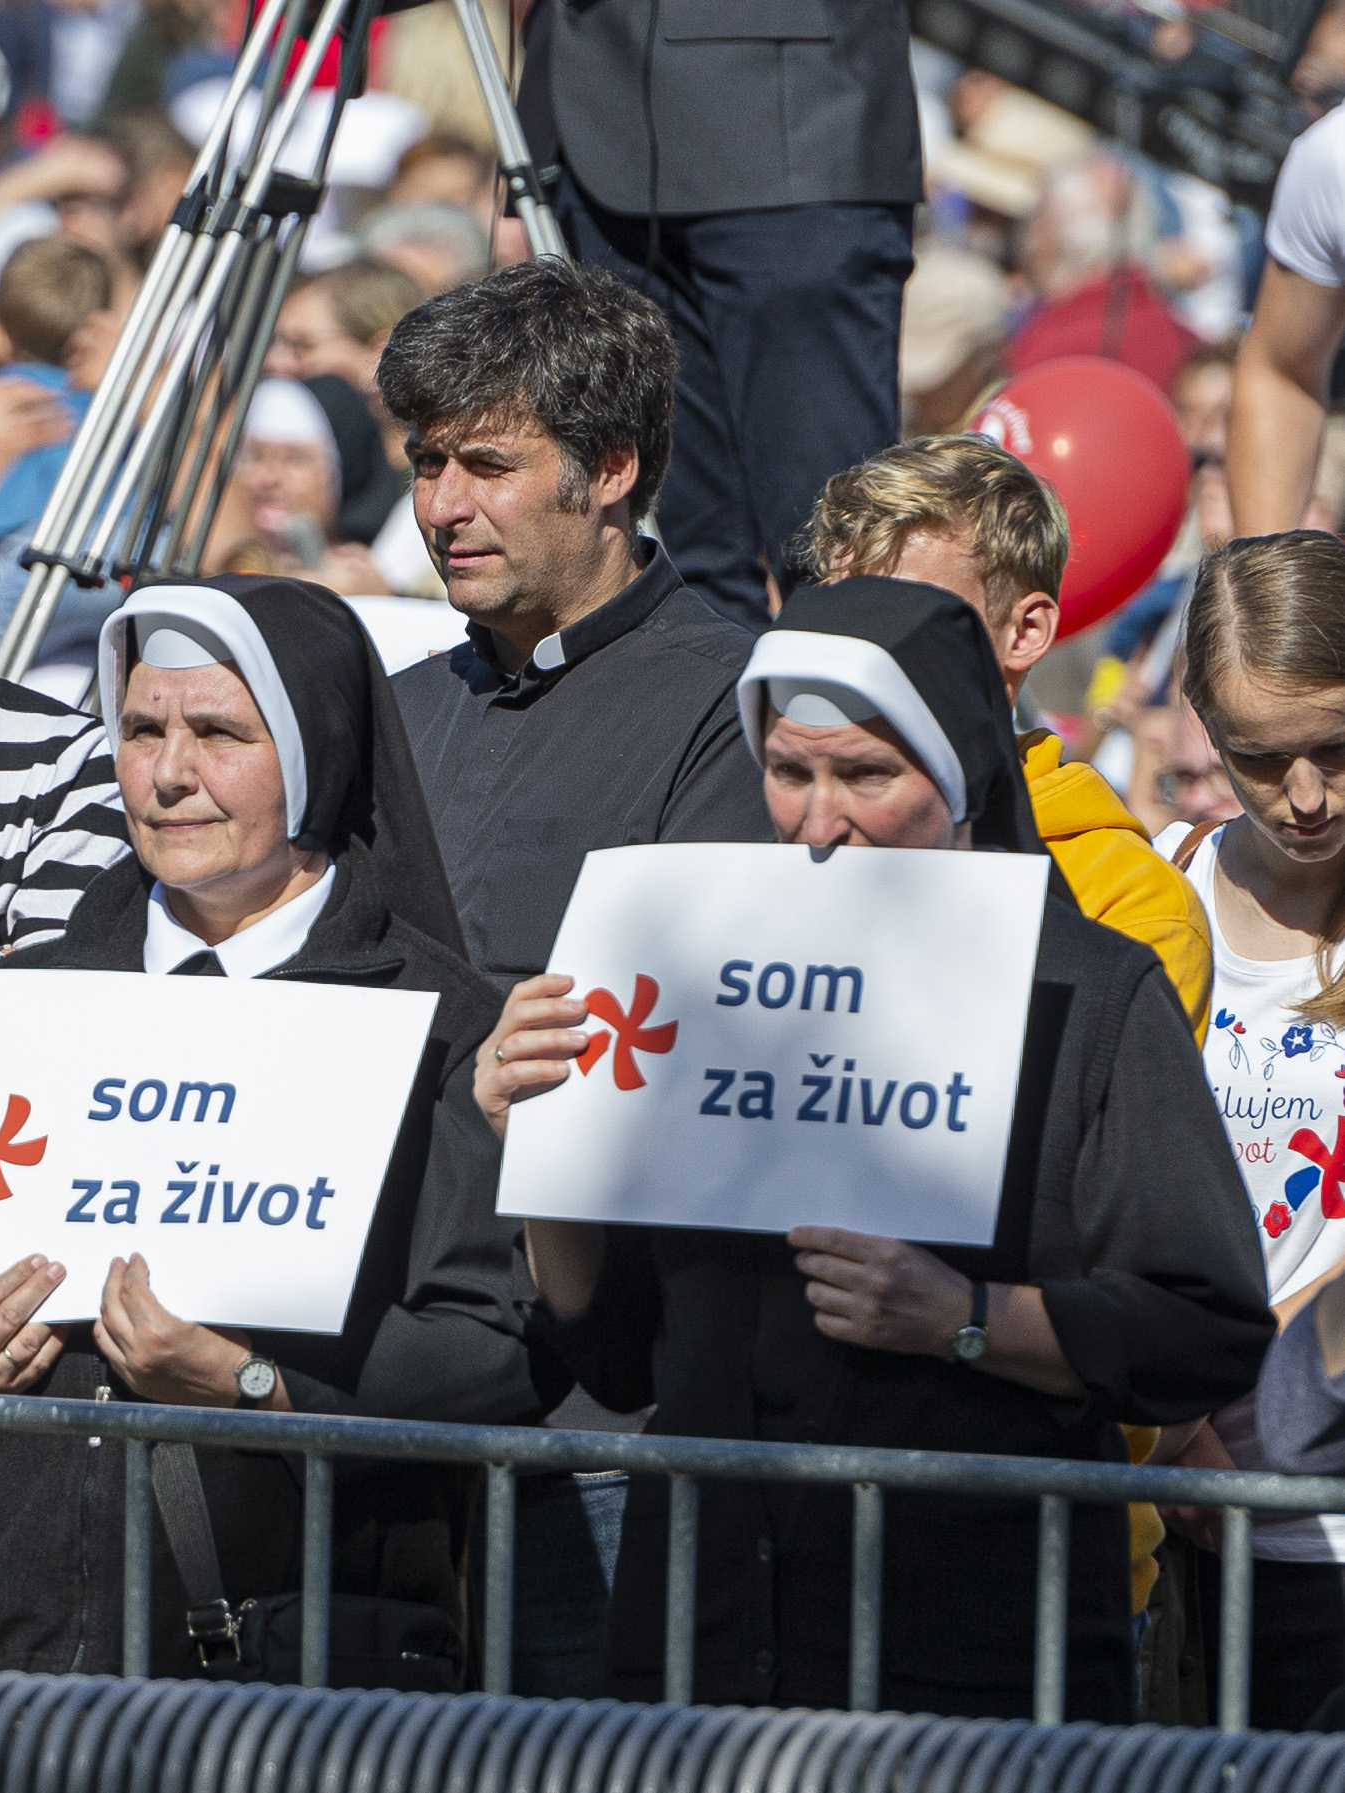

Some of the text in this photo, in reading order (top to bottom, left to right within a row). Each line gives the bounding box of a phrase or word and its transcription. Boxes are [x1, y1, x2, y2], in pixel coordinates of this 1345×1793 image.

[715, 958, 866, 1014] som
[87, 1076, 238, 1124] som
[699, 1053, 974, 1132] za život
[64, 1160, 336, 1230] za život
